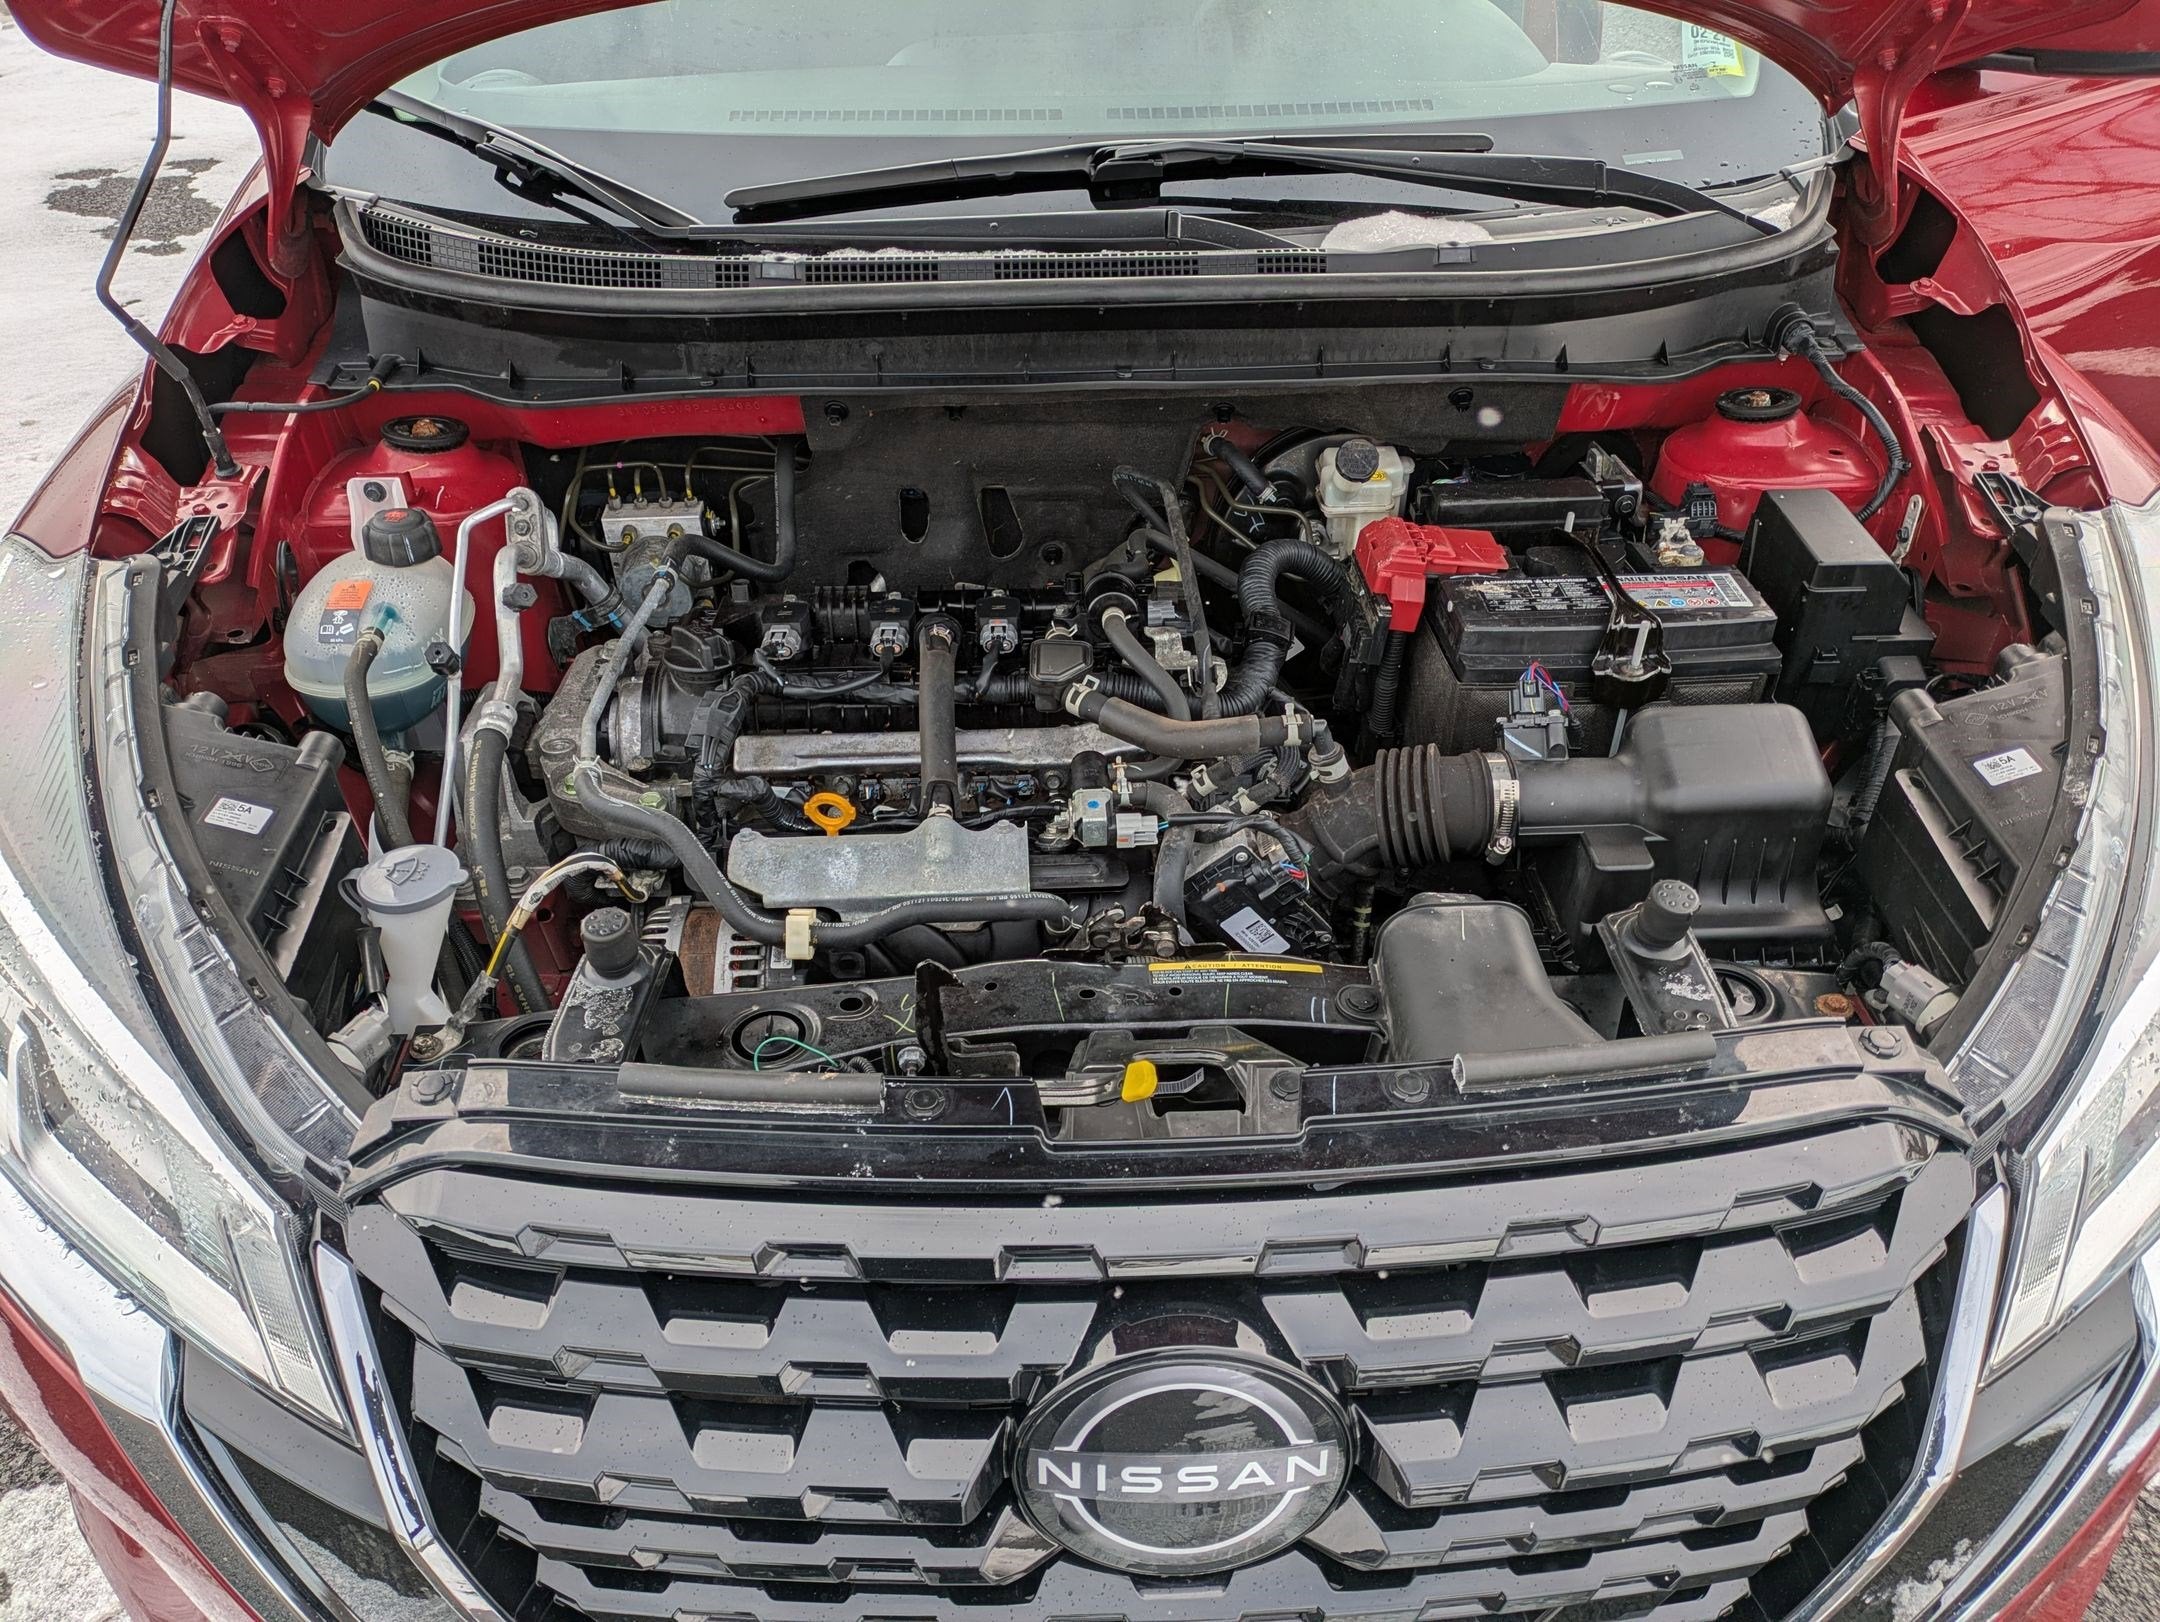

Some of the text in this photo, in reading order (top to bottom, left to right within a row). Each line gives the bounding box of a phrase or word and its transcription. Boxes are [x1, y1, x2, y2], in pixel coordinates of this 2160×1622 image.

[1999, 755, 2016, 767] 5A
[237, 804, 253, 815] 5A
[1037, 1449, 1329, 1494] NISSAN
